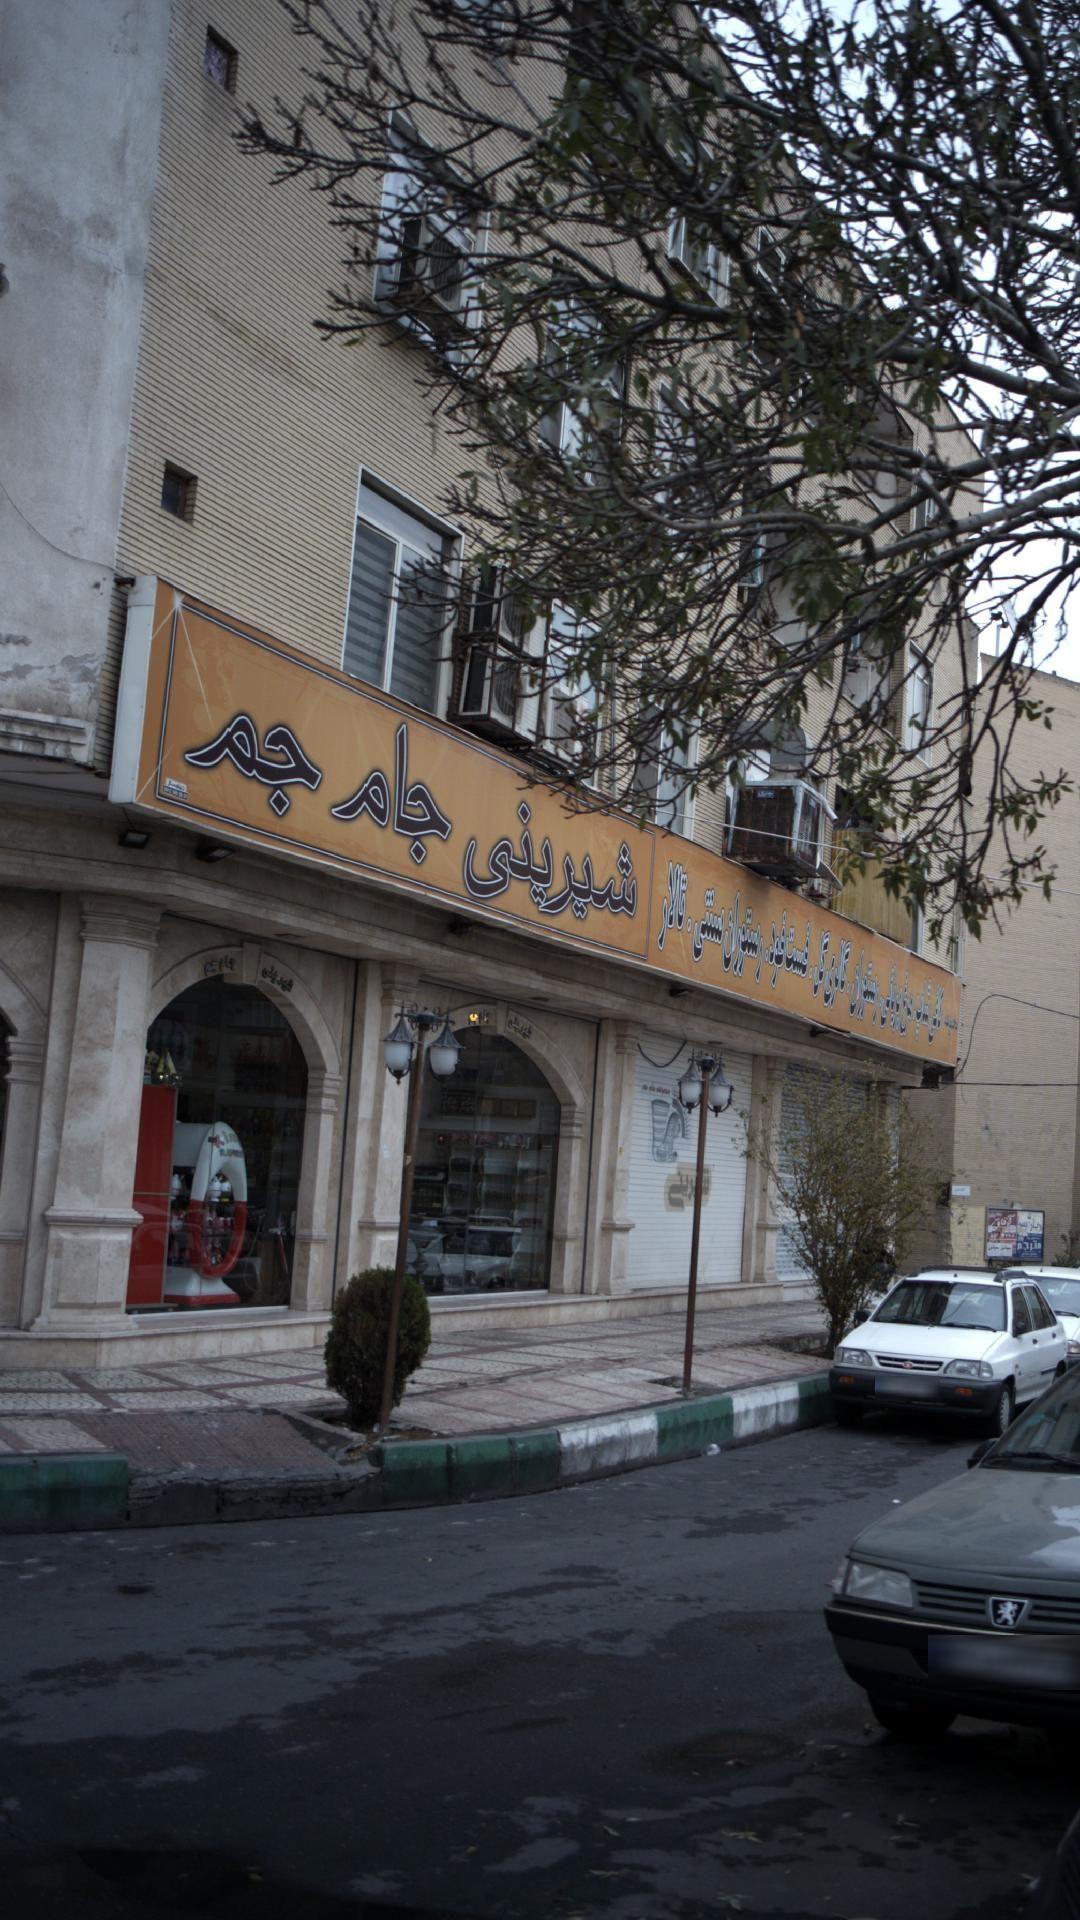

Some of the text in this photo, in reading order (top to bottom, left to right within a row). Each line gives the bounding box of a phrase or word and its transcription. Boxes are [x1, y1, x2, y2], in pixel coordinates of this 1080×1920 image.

[184, 714, 638, 920] شیرینی جام جم
[657, 860, 688, 950] تالار
[692, 887, 726, 963] سنتی
[721, 890, 764, 985] رستوران
[768, 908, 787, 990] فود
[785, 921, 811, 978] فست
[812, 928, 832, 998] گل
